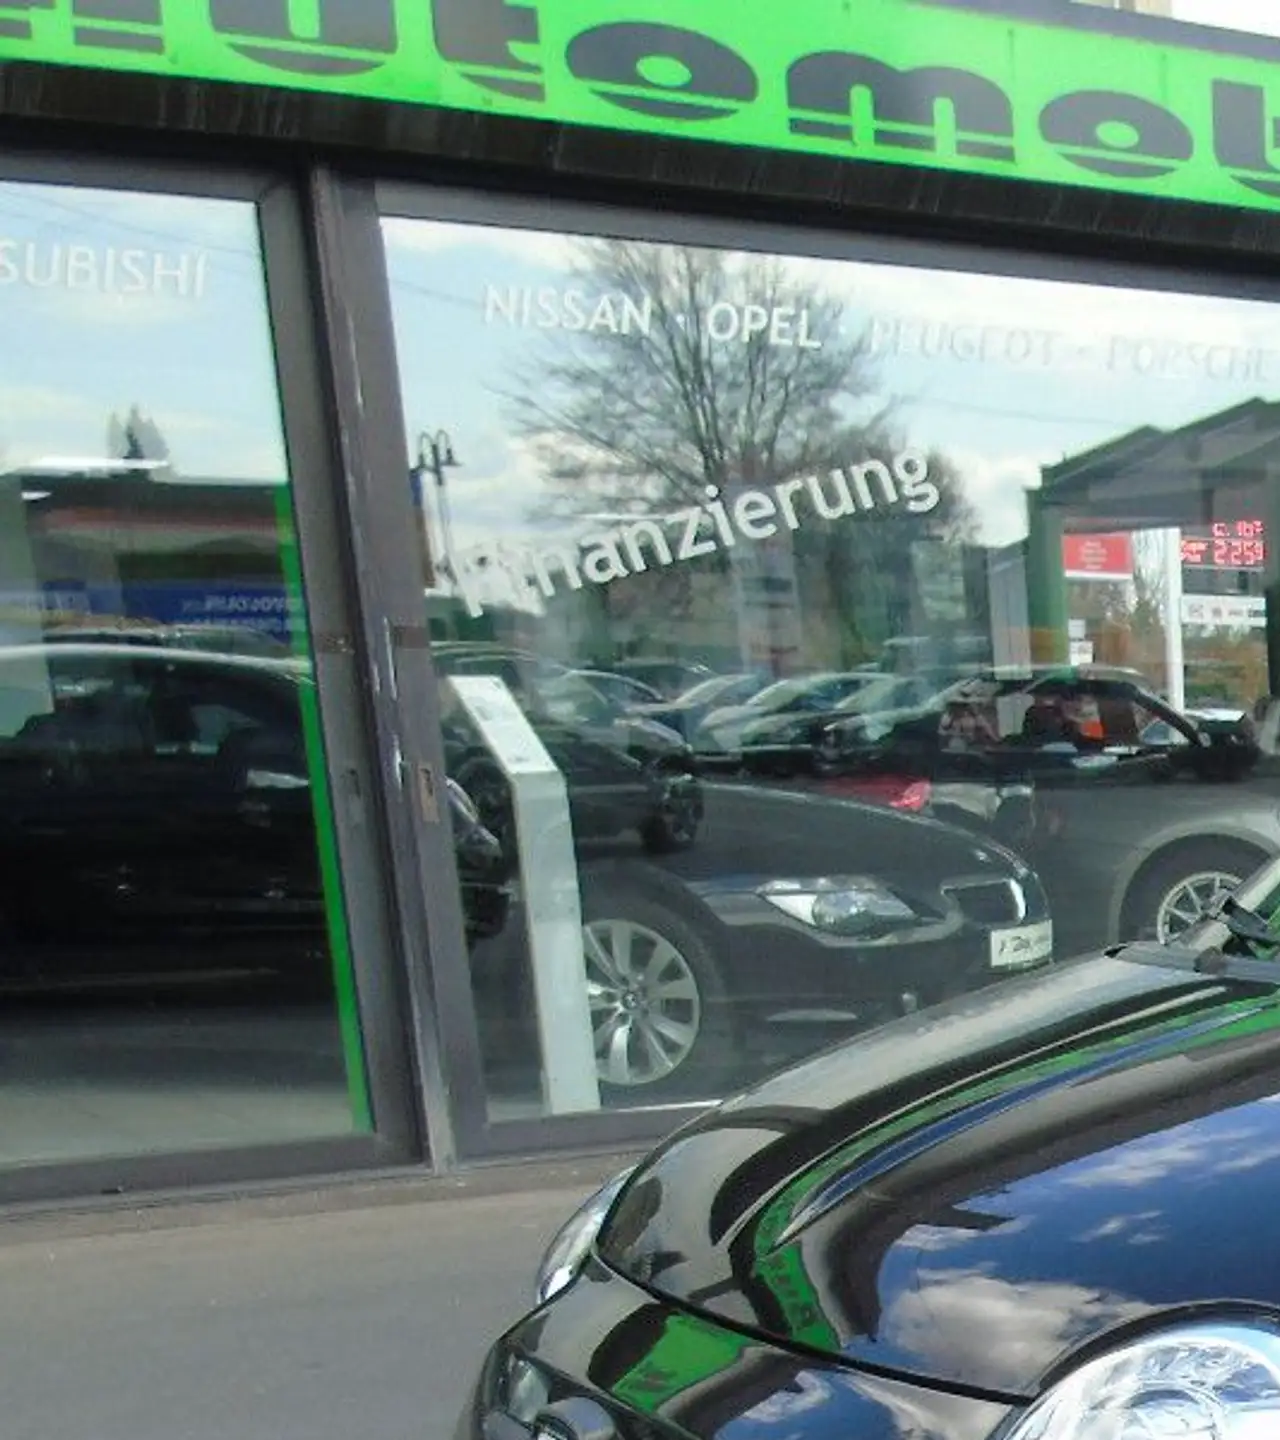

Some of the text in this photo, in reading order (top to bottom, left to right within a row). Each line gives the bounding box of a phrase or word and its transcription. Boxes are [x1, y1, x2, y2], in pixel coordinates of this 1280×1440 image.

[483, 285, 1280, 383] NISSAN OPEL PEUGEOT PORSCHE
